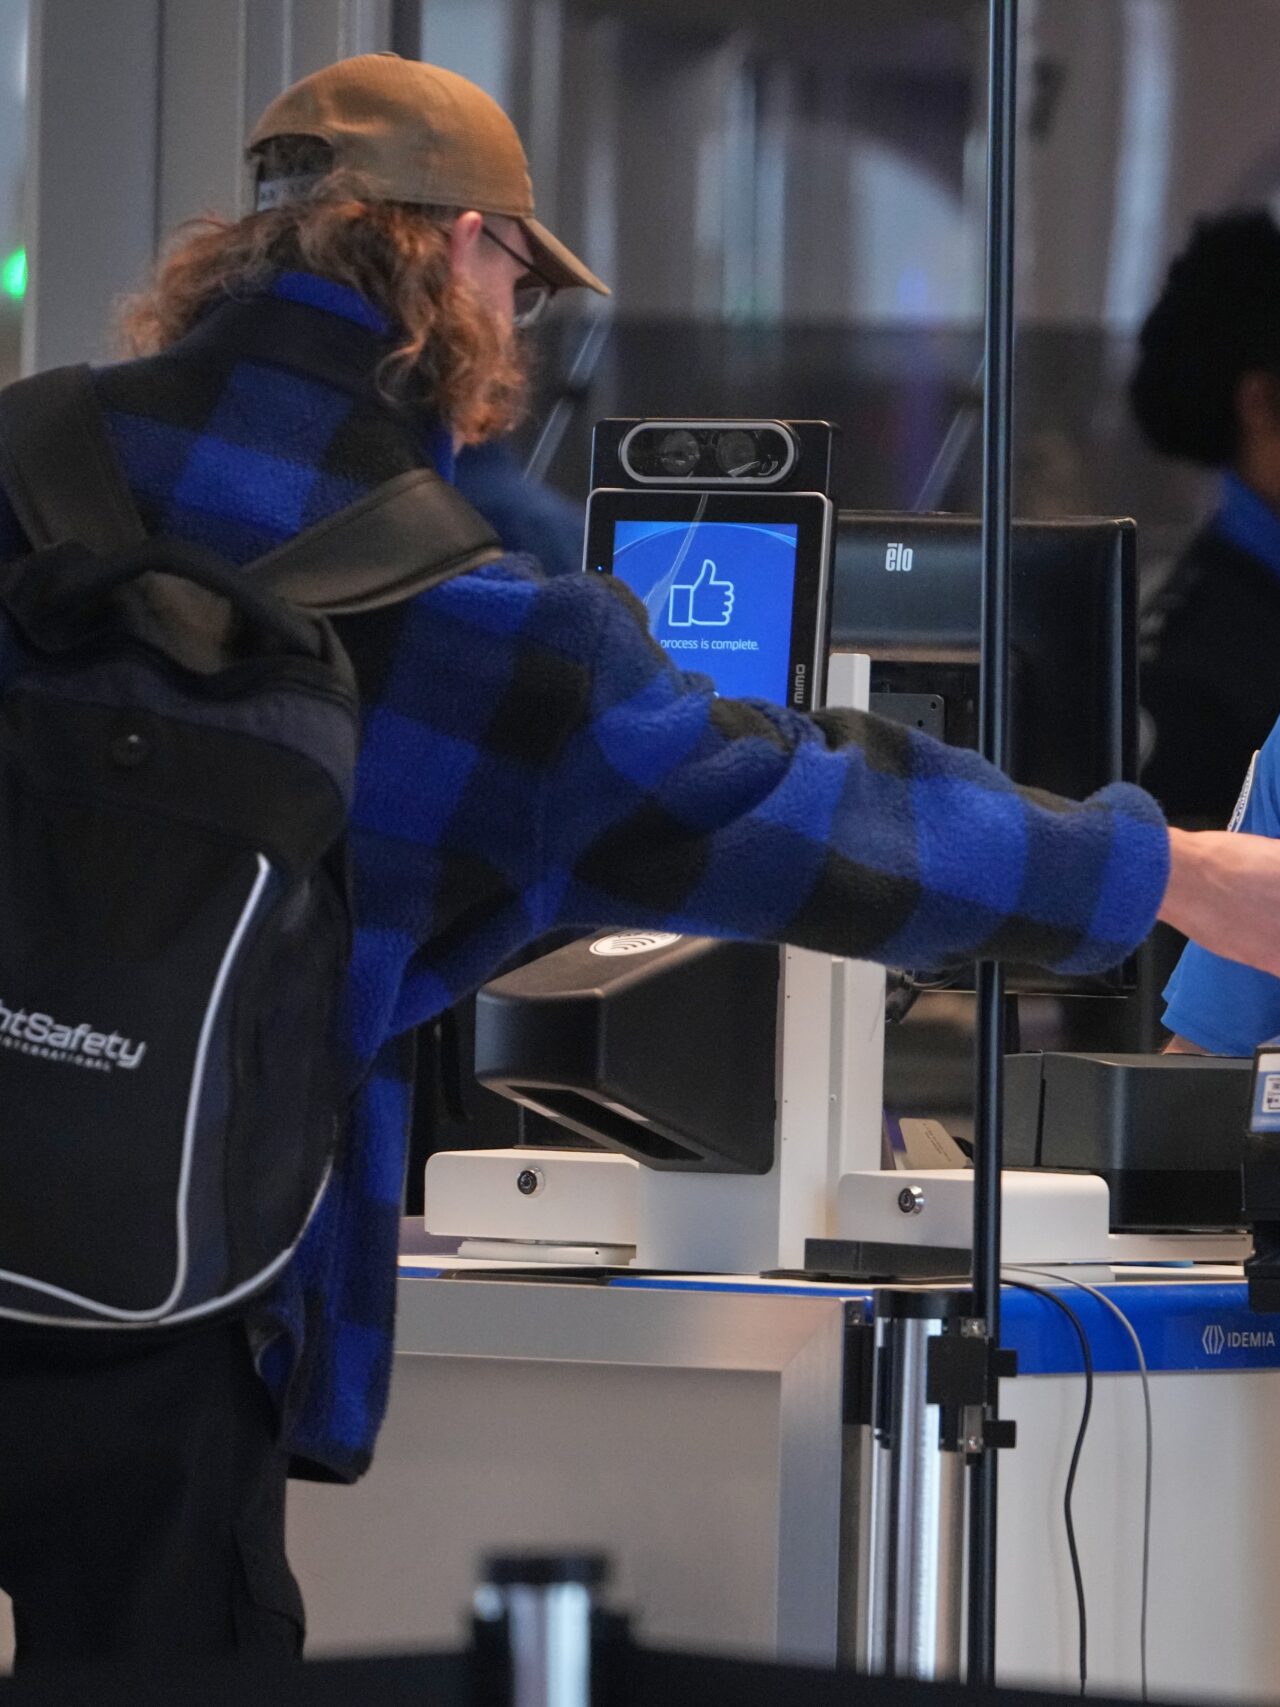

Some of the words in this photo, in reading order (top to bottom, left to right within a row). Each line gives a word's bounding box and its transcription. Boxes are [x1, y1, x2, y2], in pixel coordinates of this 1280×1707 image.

[660, 639, 699, 649] process
[700, 638, 710, 649] is
[711, 639, 759, 651] complete.
[793, 663, 806, 704] mimo
[1227, 1332, 1276, 1347] IDEMIA
